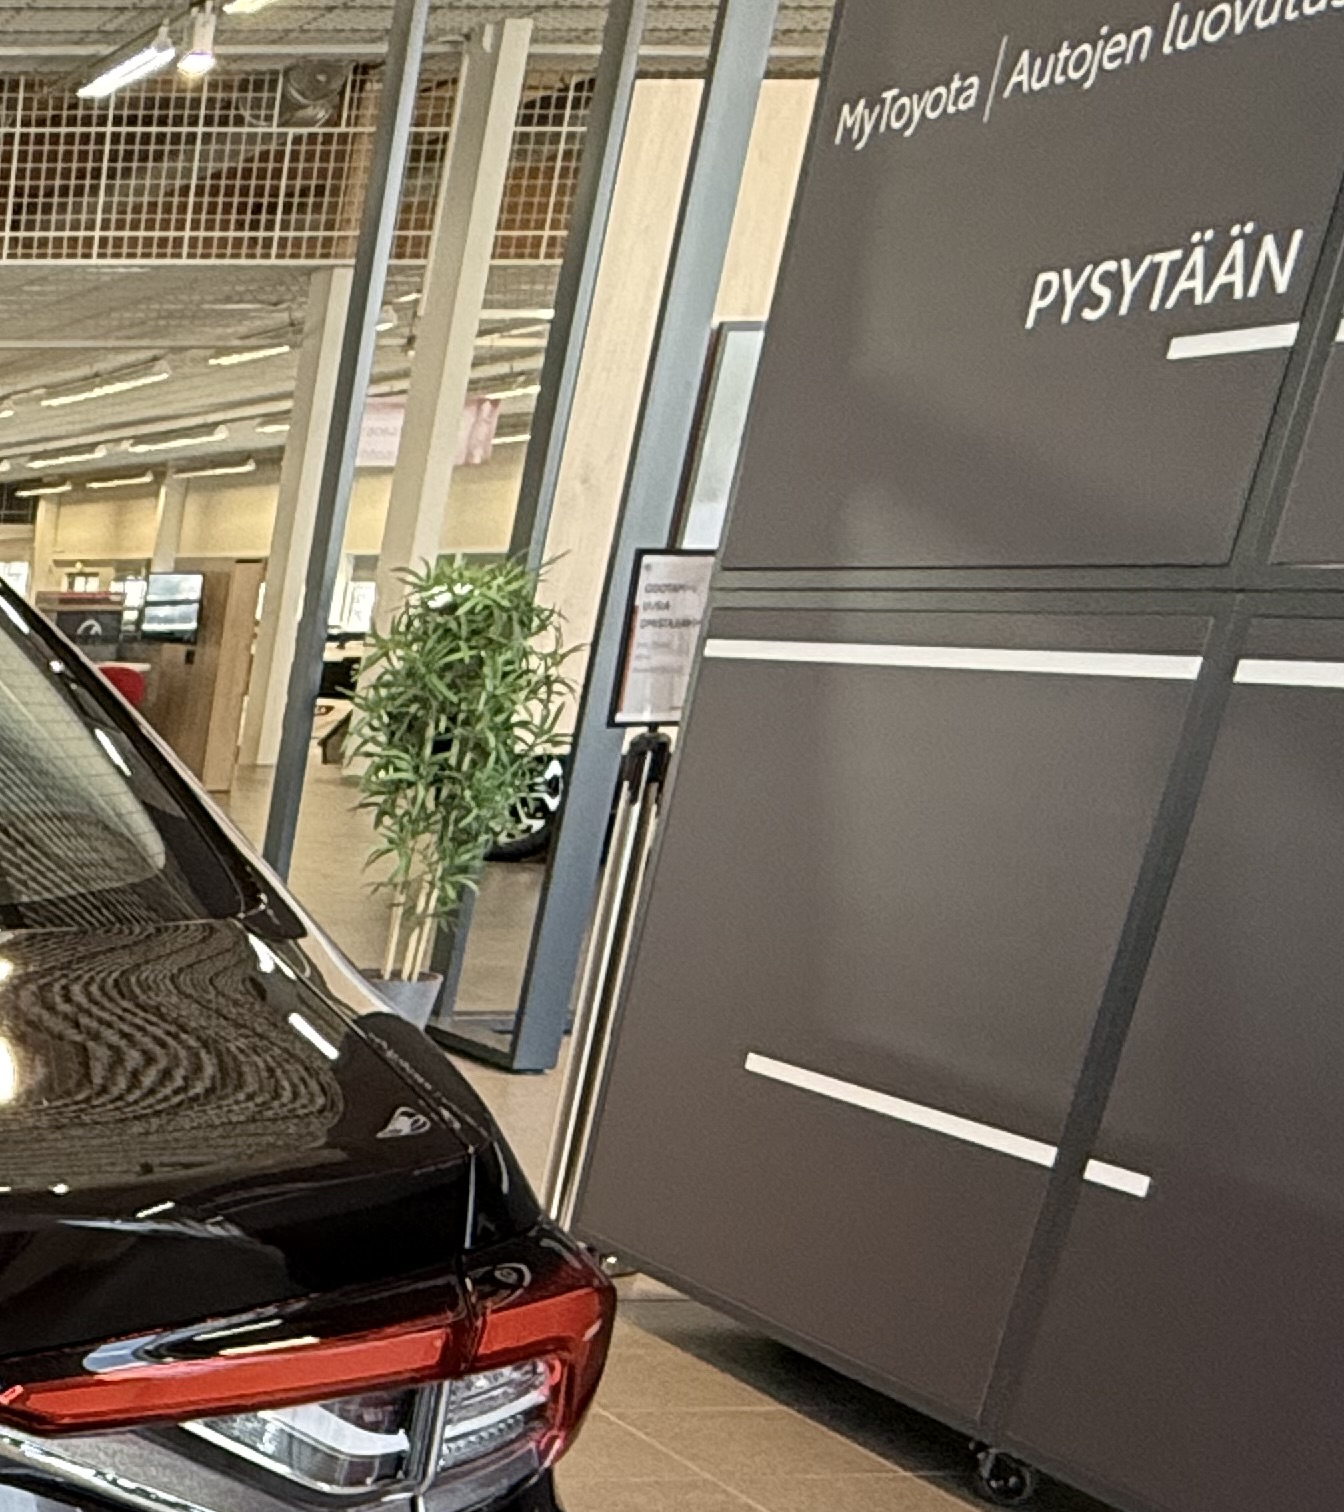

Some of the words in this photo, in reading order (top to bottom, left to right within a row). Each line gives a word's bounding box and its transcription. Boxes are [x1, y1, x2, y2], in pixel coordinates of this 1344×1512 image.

[834, 73, 979, 150] MyToyota
[1002, 25, 1152, 98] Autojen
[1025, 221, 1304, 329] PYSYTÄÄN
